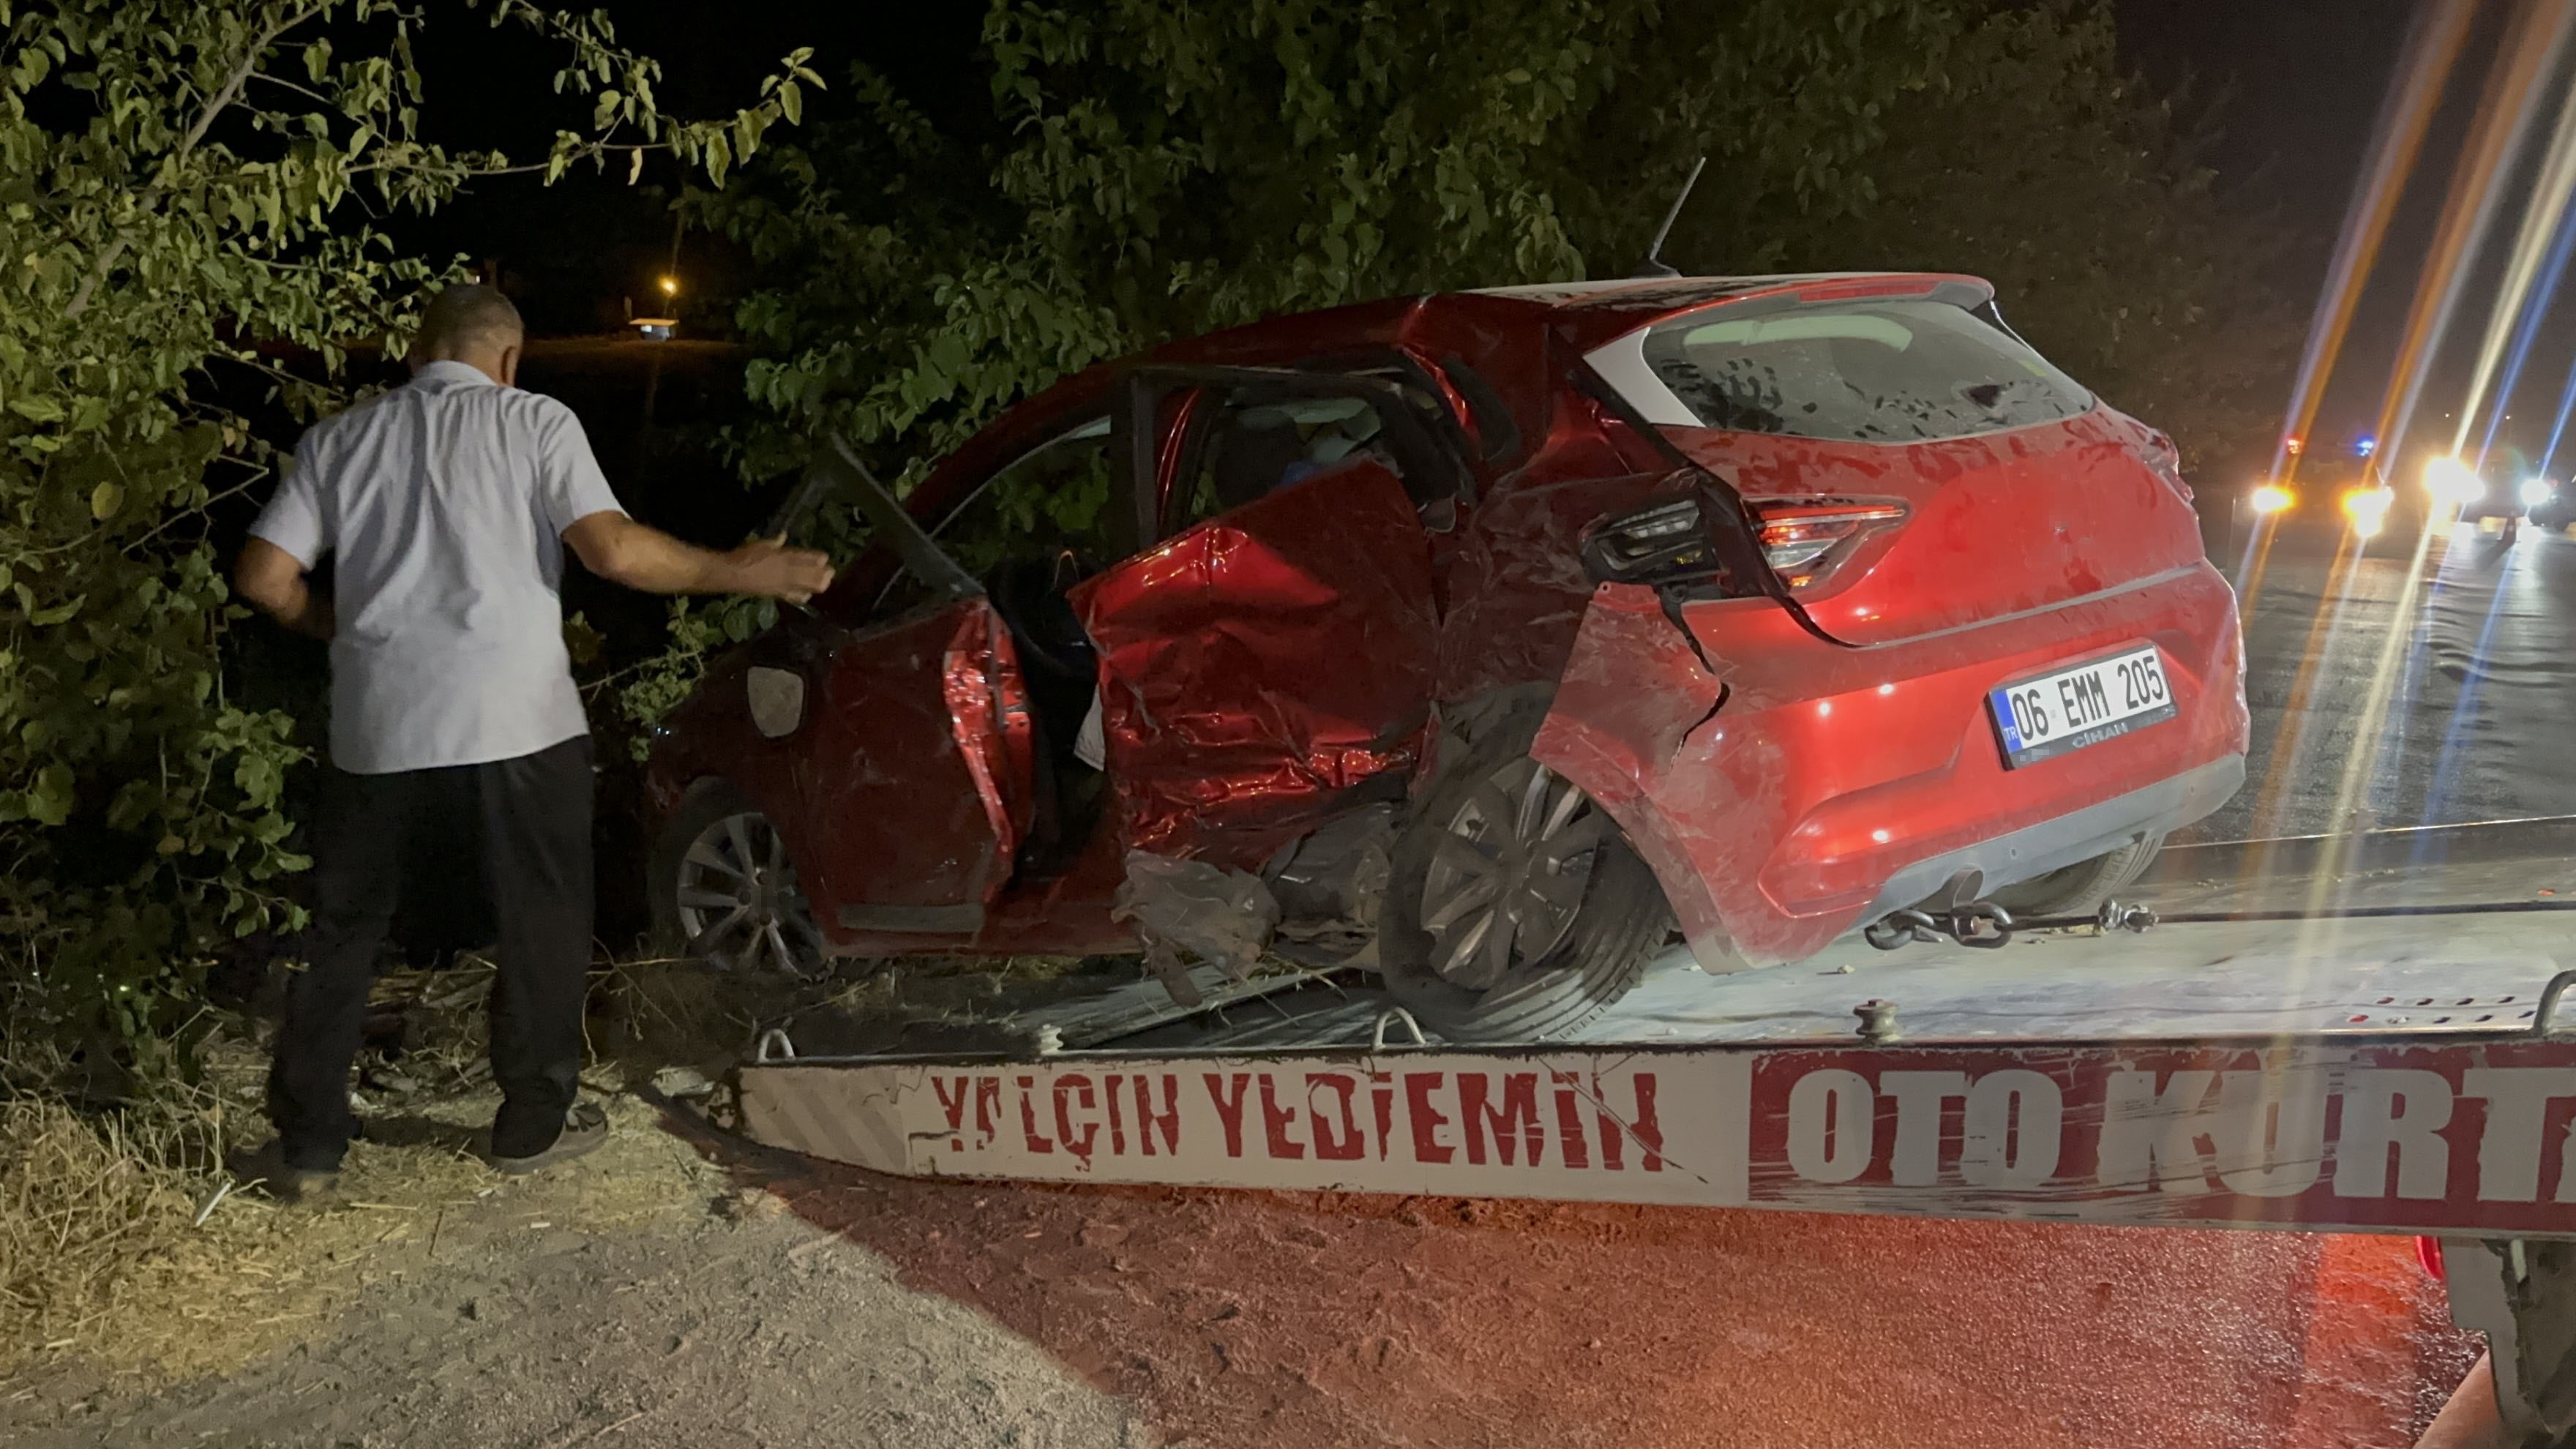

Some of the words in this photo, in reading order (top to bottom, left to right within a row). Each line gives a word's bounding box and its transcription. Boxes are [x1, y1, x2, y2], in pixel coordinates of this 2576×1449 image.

[2004, 727, 2018, 741] TR
[2012, 689, 2049, 741] 06
[2057, 670, 2111, 728] EMM
[2117, 655, 2164, 710] 205
[1788, 1069, 2062, 1185] OTO
[2097, 1067, 2575, 1203] KURT
